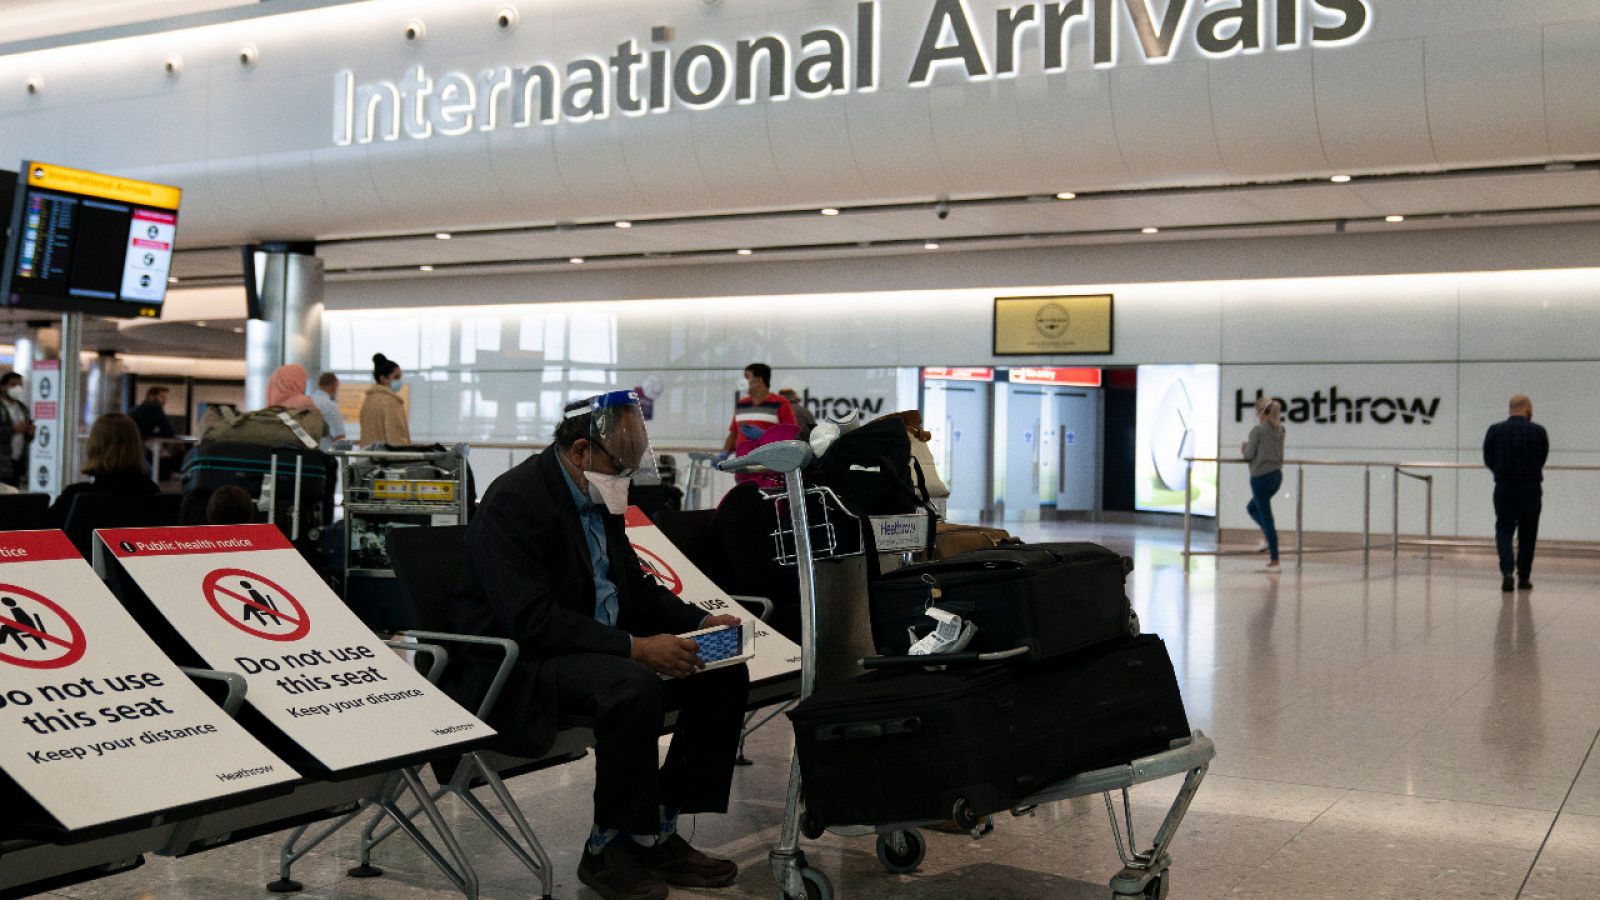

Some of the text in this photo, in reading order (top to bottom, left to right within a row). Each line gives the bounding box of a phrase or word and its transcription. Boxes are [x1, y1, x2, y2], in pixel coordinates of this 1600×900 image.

[333, 0, 1375, 145] International Arrivals
[1235, 386, 1441, 425] Hathrow
[135, 537, 254, 551] Public health notice
[700, 598, 729, 611] use
[234, 644, 376, 675] Do not use
[36, 677, 104, 702] not
[103, 672, 165, 692] use
[276, 665, 388, 695] this seat
[22, 697, 175, 735] this seat
[286, 688, 425, 719] Keep your distance
[27, 722, 219, 764] Keep your distance
[431, 723, 476, 736] Heathrow
[215, 764, 274, 782] Heathrow
